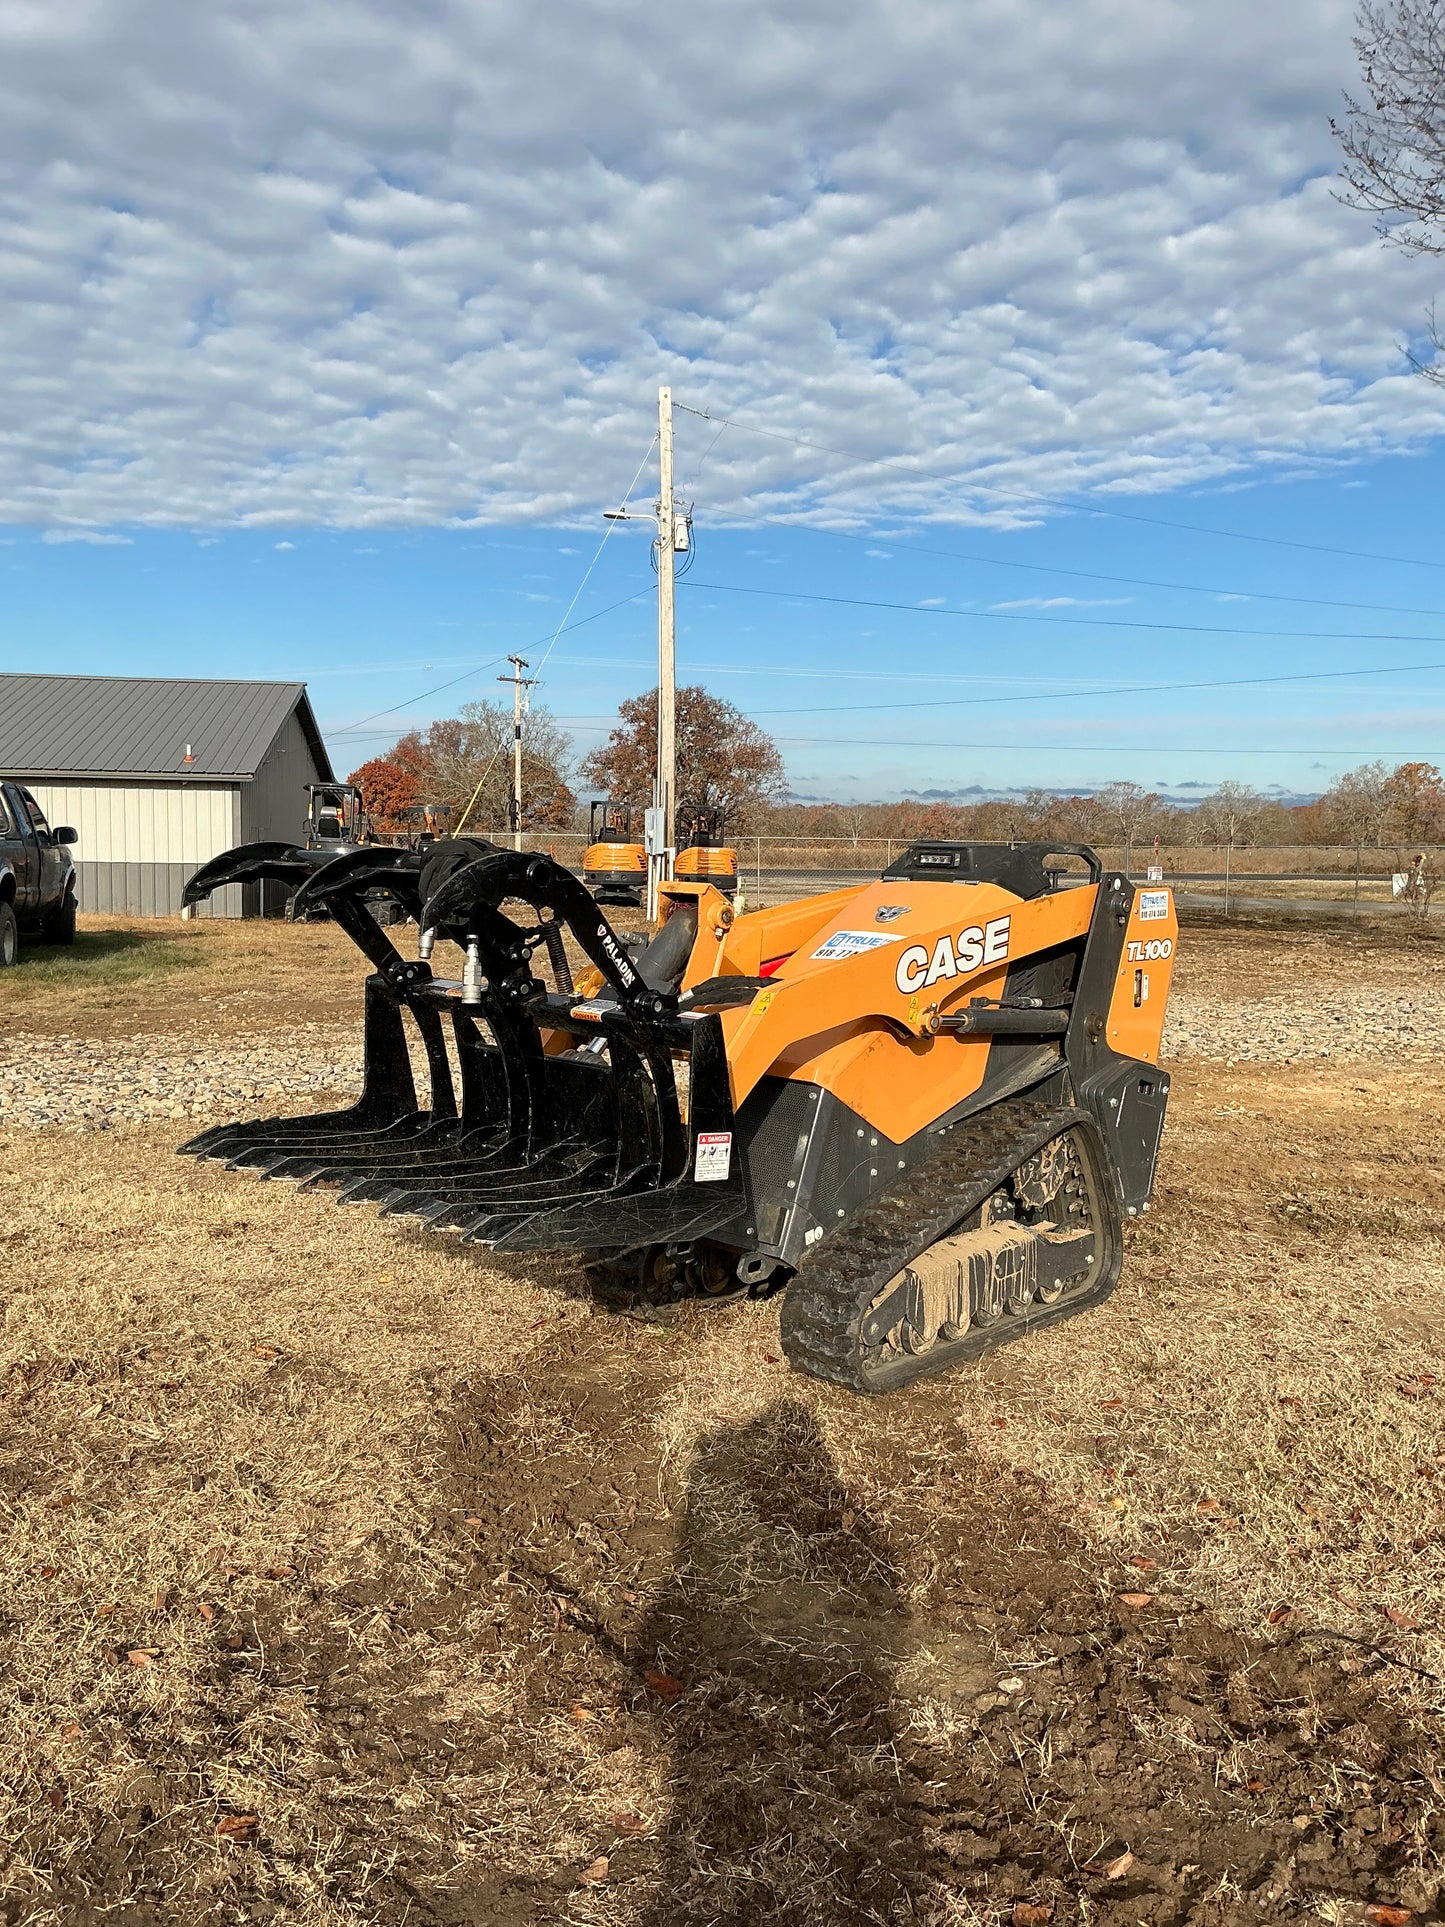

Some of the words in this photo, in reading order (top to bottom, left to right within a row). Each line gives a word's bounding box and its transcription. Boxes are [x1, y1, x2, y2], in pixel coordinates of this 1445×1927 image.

[845, 935, 883, 946] TRUE
[895, 914, 1012, 995] CASE
[1127, 938, 1172, 962] TL100
[602, 935, 634, 985] PALADIN
